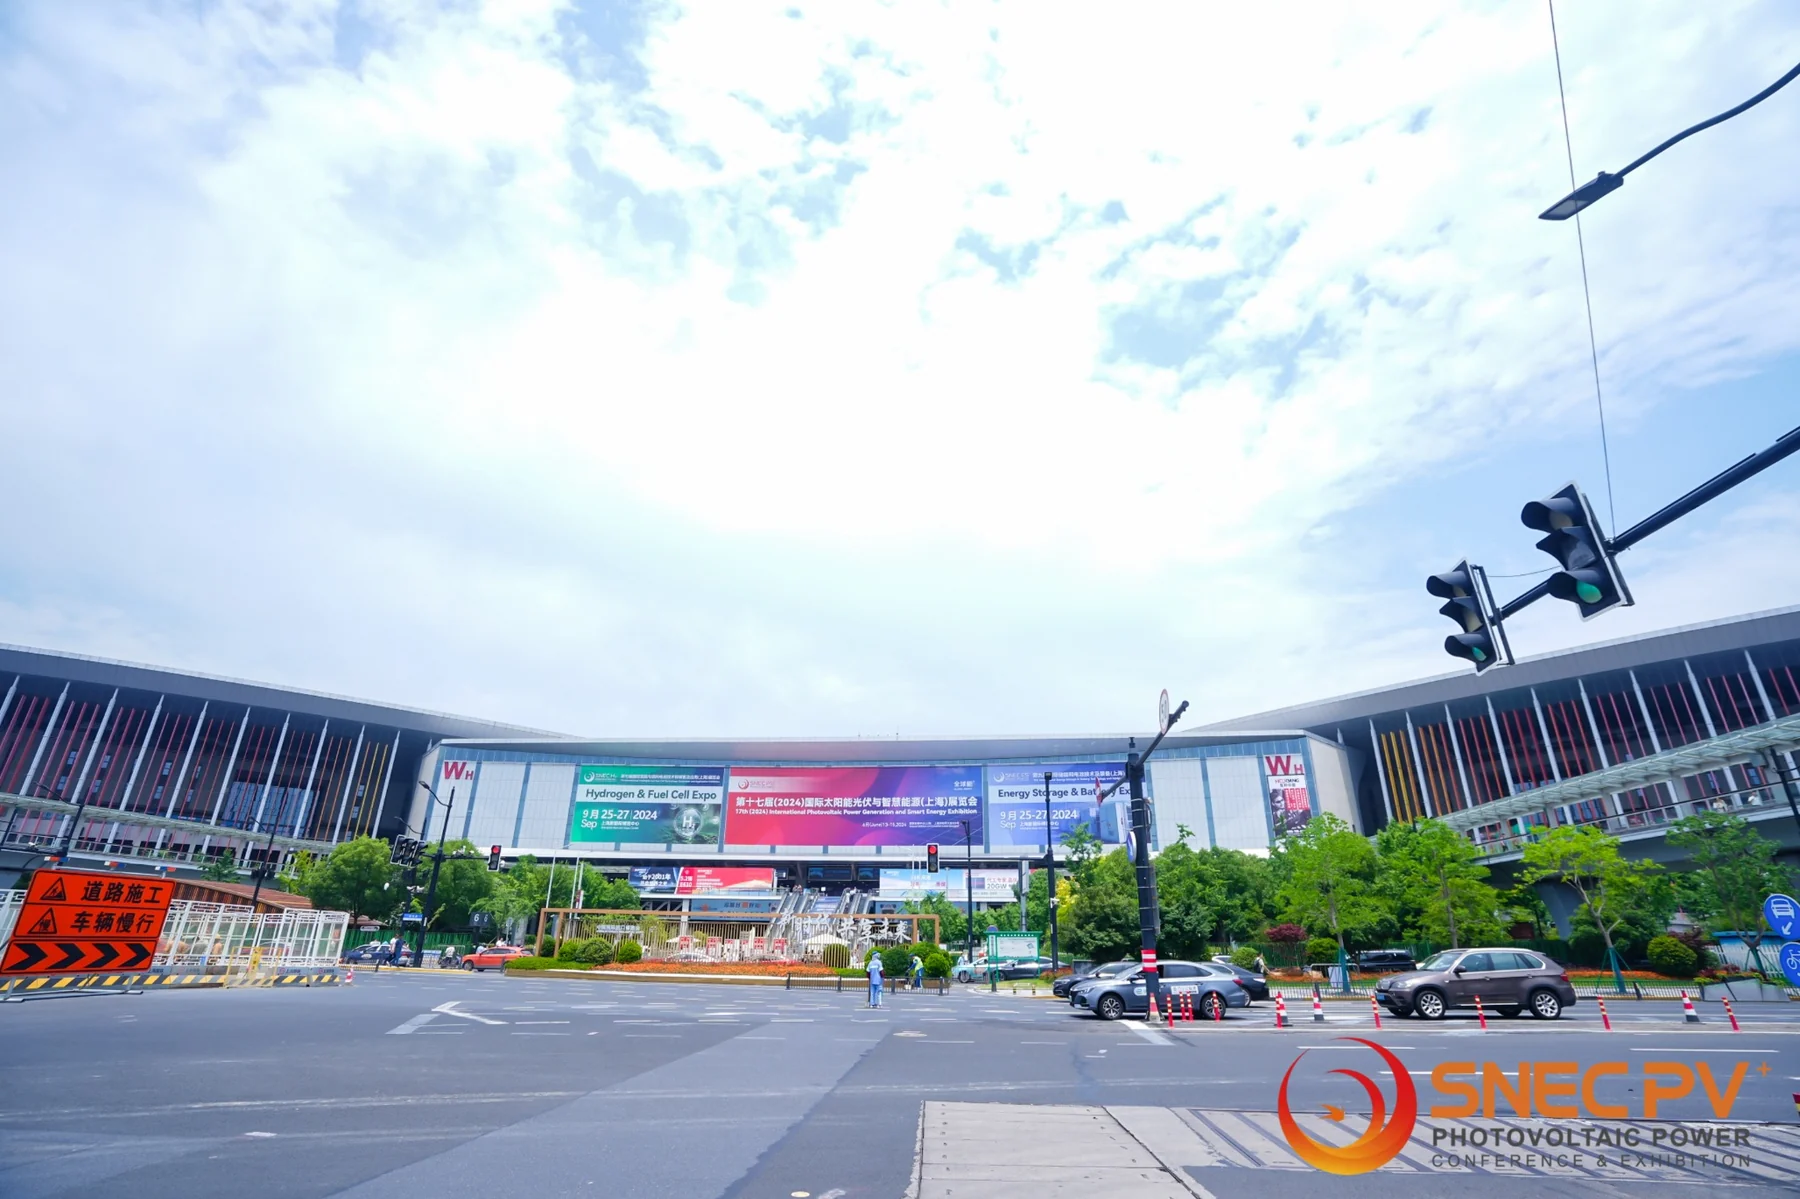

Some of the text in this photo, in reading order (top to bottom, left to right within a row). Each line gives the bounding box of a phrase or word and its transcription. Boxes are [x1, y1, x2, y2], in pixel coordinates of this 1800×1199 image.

[585, 789, 717, 802] Hydrogen & Fuel Cell Expo
[998, 789, 1030, 799] Energy
[1071, 787, 1079, 797] &
[600, 809, 630, 820] 25-27
[632, 810, 658, 820] 2024
[926, 808, 947, 816] Energy
[1019, 809, 1048, 820] 25-27
[1051, 809, 1078, 820] 2024
[580, 819, 598, 829] Sep
[1000, 820, 1017, 831] Sep
[81, 881, 163, 904] 道路施工
[70, 911, 155, 933] 车辆慢行
